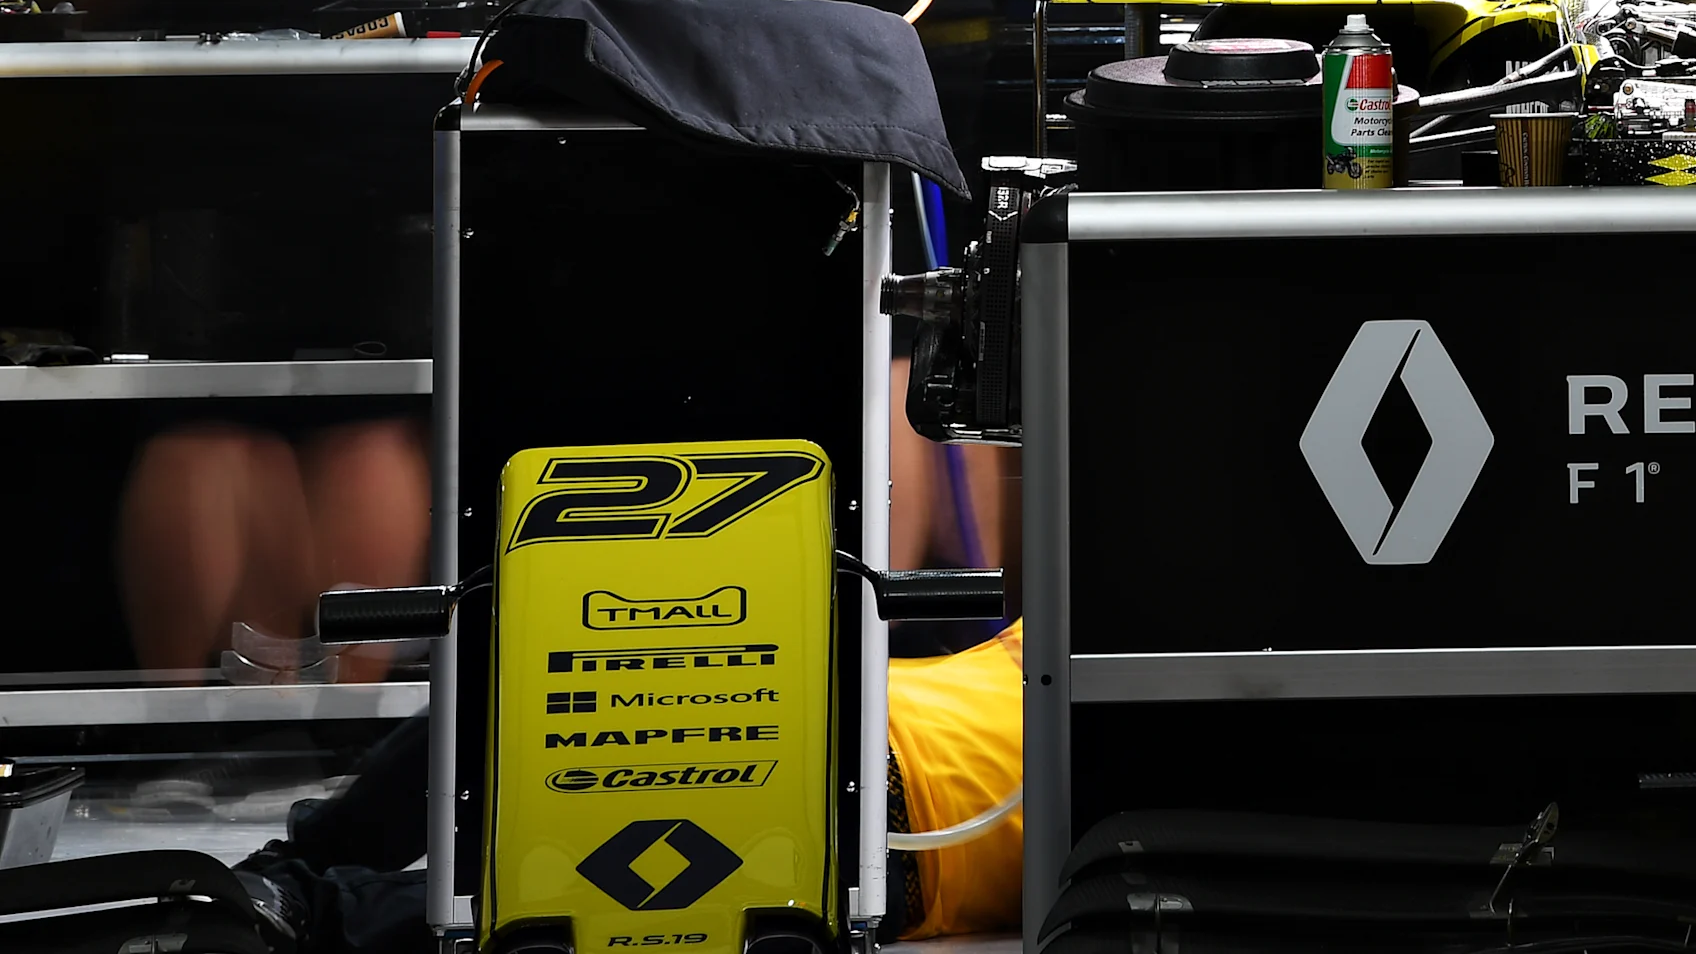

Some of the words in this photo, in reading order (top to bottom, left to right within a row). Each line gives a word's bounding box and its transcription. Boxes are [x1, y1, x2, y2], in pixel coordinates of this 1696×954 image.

[1351, 128, 1375, 136] Parts
[505, 450, 826, 555] 27
[597, 604, 731, 622] TMALL
[547, 643, 779, 673] PIRELLI
[610, 688, 779, 708] Microsoft
[545, 725, 779, 748] MAPFRE
[602, 764, 757, 788] Castrol
[607, 933, 708, 947] R.S.19
